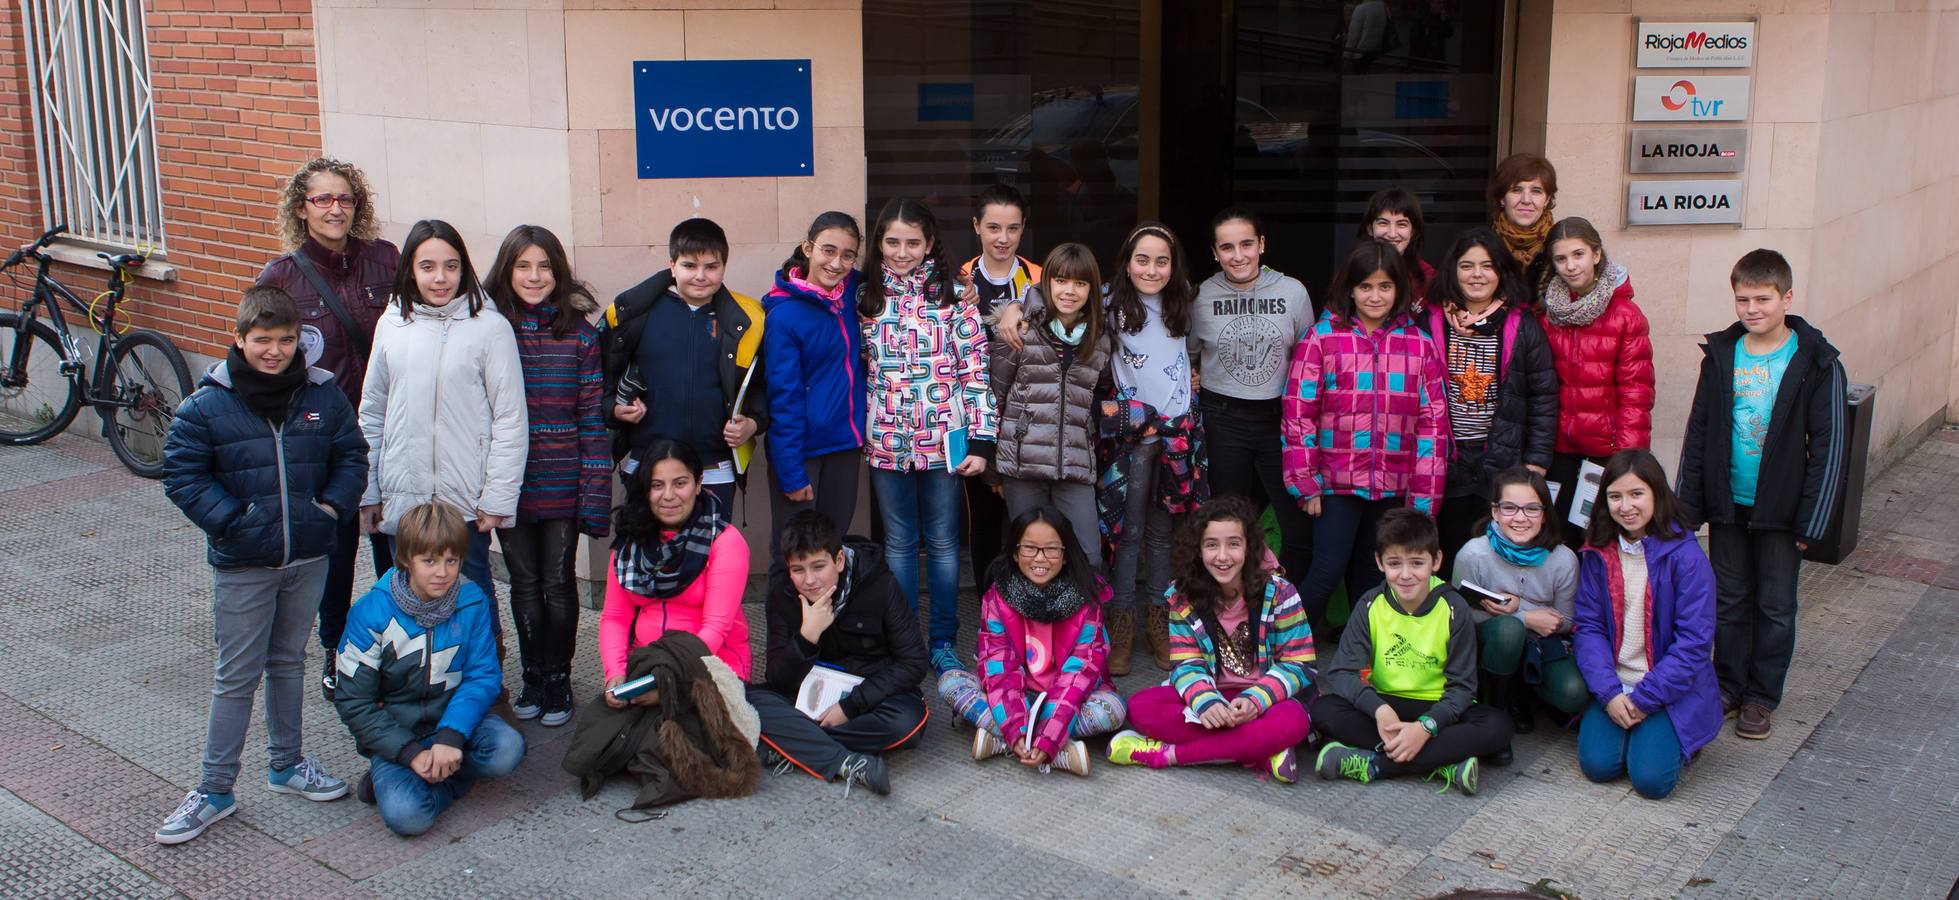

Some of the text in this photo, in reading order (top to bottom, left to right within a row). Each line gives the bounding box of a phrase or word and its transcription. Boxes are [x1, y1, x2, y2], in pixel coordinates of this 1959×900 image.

[1645, 31, 1748, 54] RiojaMedios
[1691, 96, 1723, 117] tvr
[649, 106, 799, 131] vocento
[1641, 144, 1664, 158] LA
[1667, 143, 1720, 157] RIOJA
[1643, 195, 1668, 210] LA
[1674, 194, 1730, 210] RIOJA
[1213, 298, 1287, 316] RAMONES
